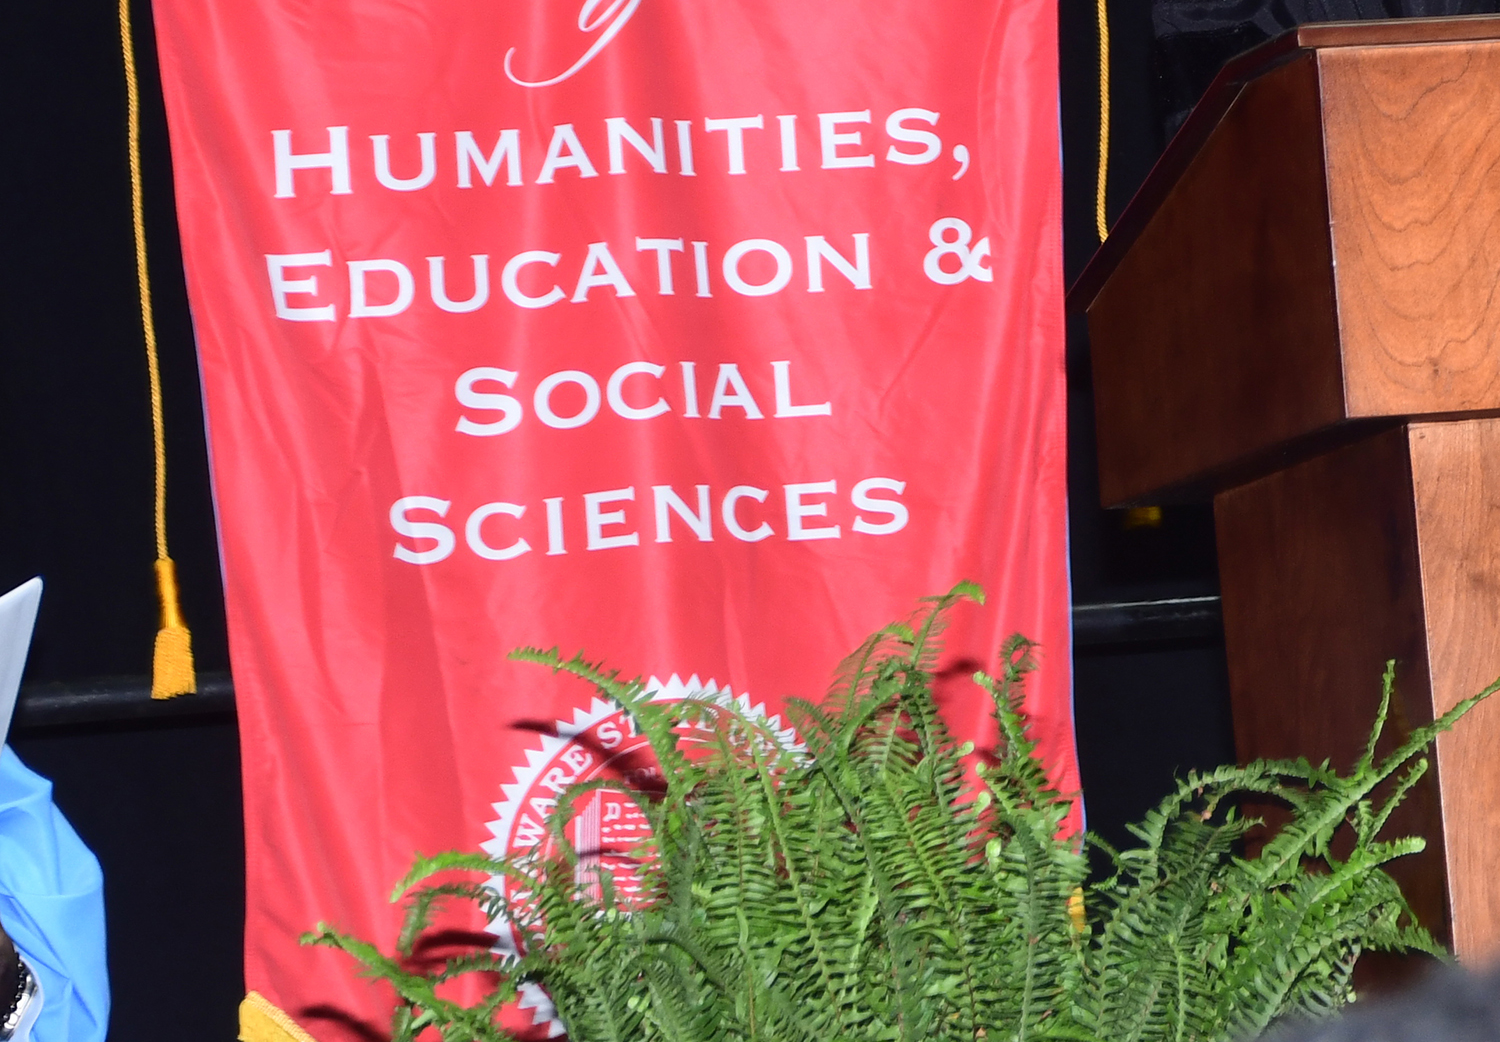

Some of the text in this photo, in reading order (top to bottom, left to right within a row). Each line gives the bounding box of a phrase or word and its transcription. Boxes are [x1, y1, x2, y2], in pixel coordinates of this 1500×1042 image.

[272, 108, 969, 198] HUMANITIES,
[265, 218, 993, 321] EDUCATION &
[456, 361, 831, 436] SOCIAL
[390, 478, 908, 564] SCIENCES
